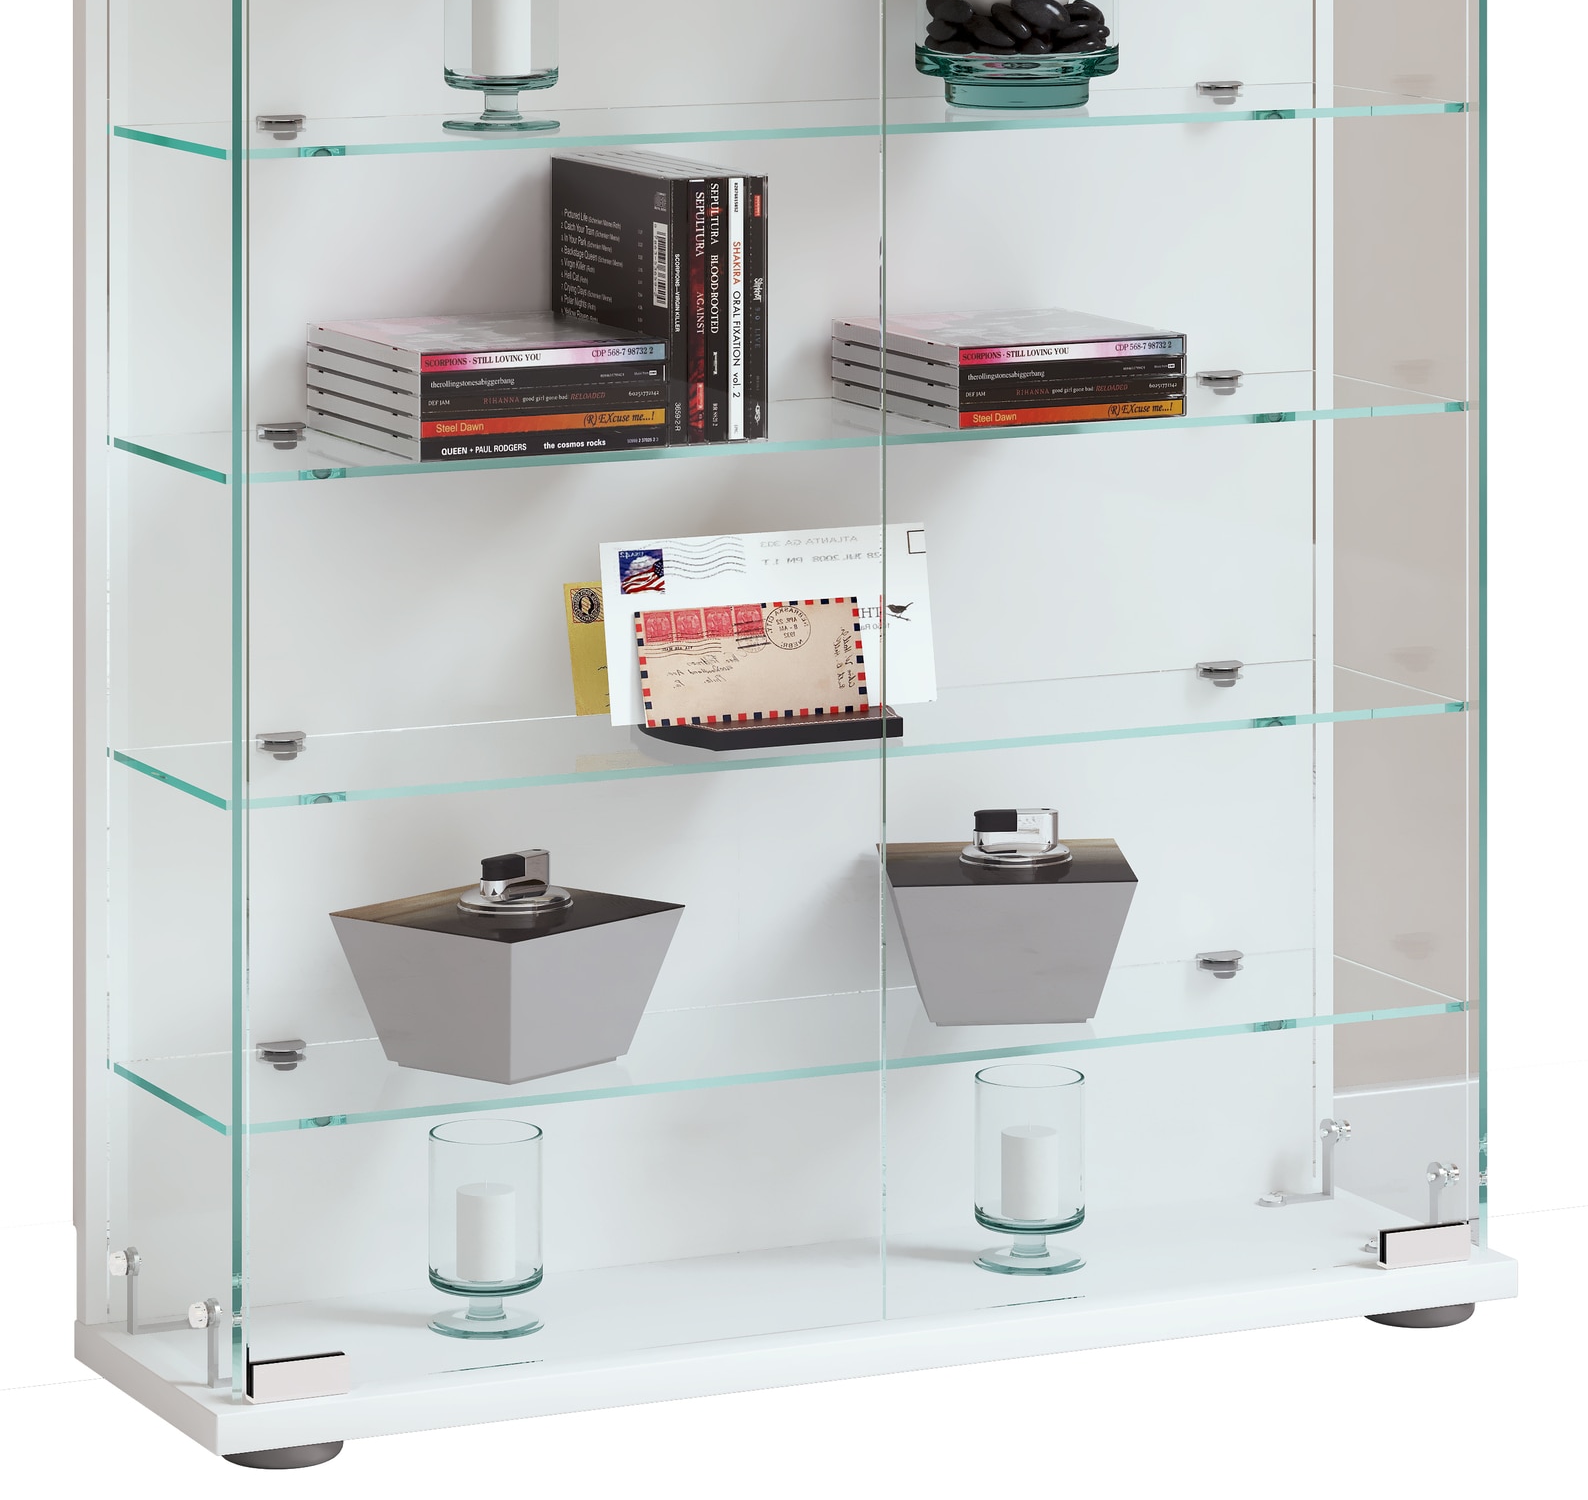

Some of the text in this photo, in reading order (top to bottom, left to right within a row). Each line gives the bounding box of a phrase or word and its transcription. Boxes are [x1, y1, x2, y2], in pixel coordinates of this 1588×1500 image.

[578, 236, 587, 247] Park
[564, 245, 584, 260] Backstage
[584, 250, 598, 262] Queen
[710, 182, 719, 334] SEPULTURA BLOOD-ROOTED
[695, 191, 705, 335] SEPULTURA AGAINST
[732, 241, 741, 388] SHAKIRA ORAL FIXATION vol.
[424, 347, 648, 368] SCORPIONS STILL LOVING YOU CDP 568-7 98732
[962, 342, 1167, 361] SCORPIONS STILL LOVING YOU CDP 98732
[430, 377, 515, 389] therollingstonesabiggerbang
[967, 370, 1045, 381] therollingstonesabiggerbang
[483, 392, 605, 405] RIHANNA RELOADED
[1016, 384, 1128, 396] RIHANNA RELOADED
[972, 404, 1151, 423] Steel Dawn (R) EXcuse
[435, 423, 458, 433] Steel
[460, 422, 484, 432] Dawn
[584, 414, 597, 427] (R)
[598, 414, 630, 424] EXcuse
[441, 439, 606, 456] QUEEN PAUL RODGERS the cosmos rocks
